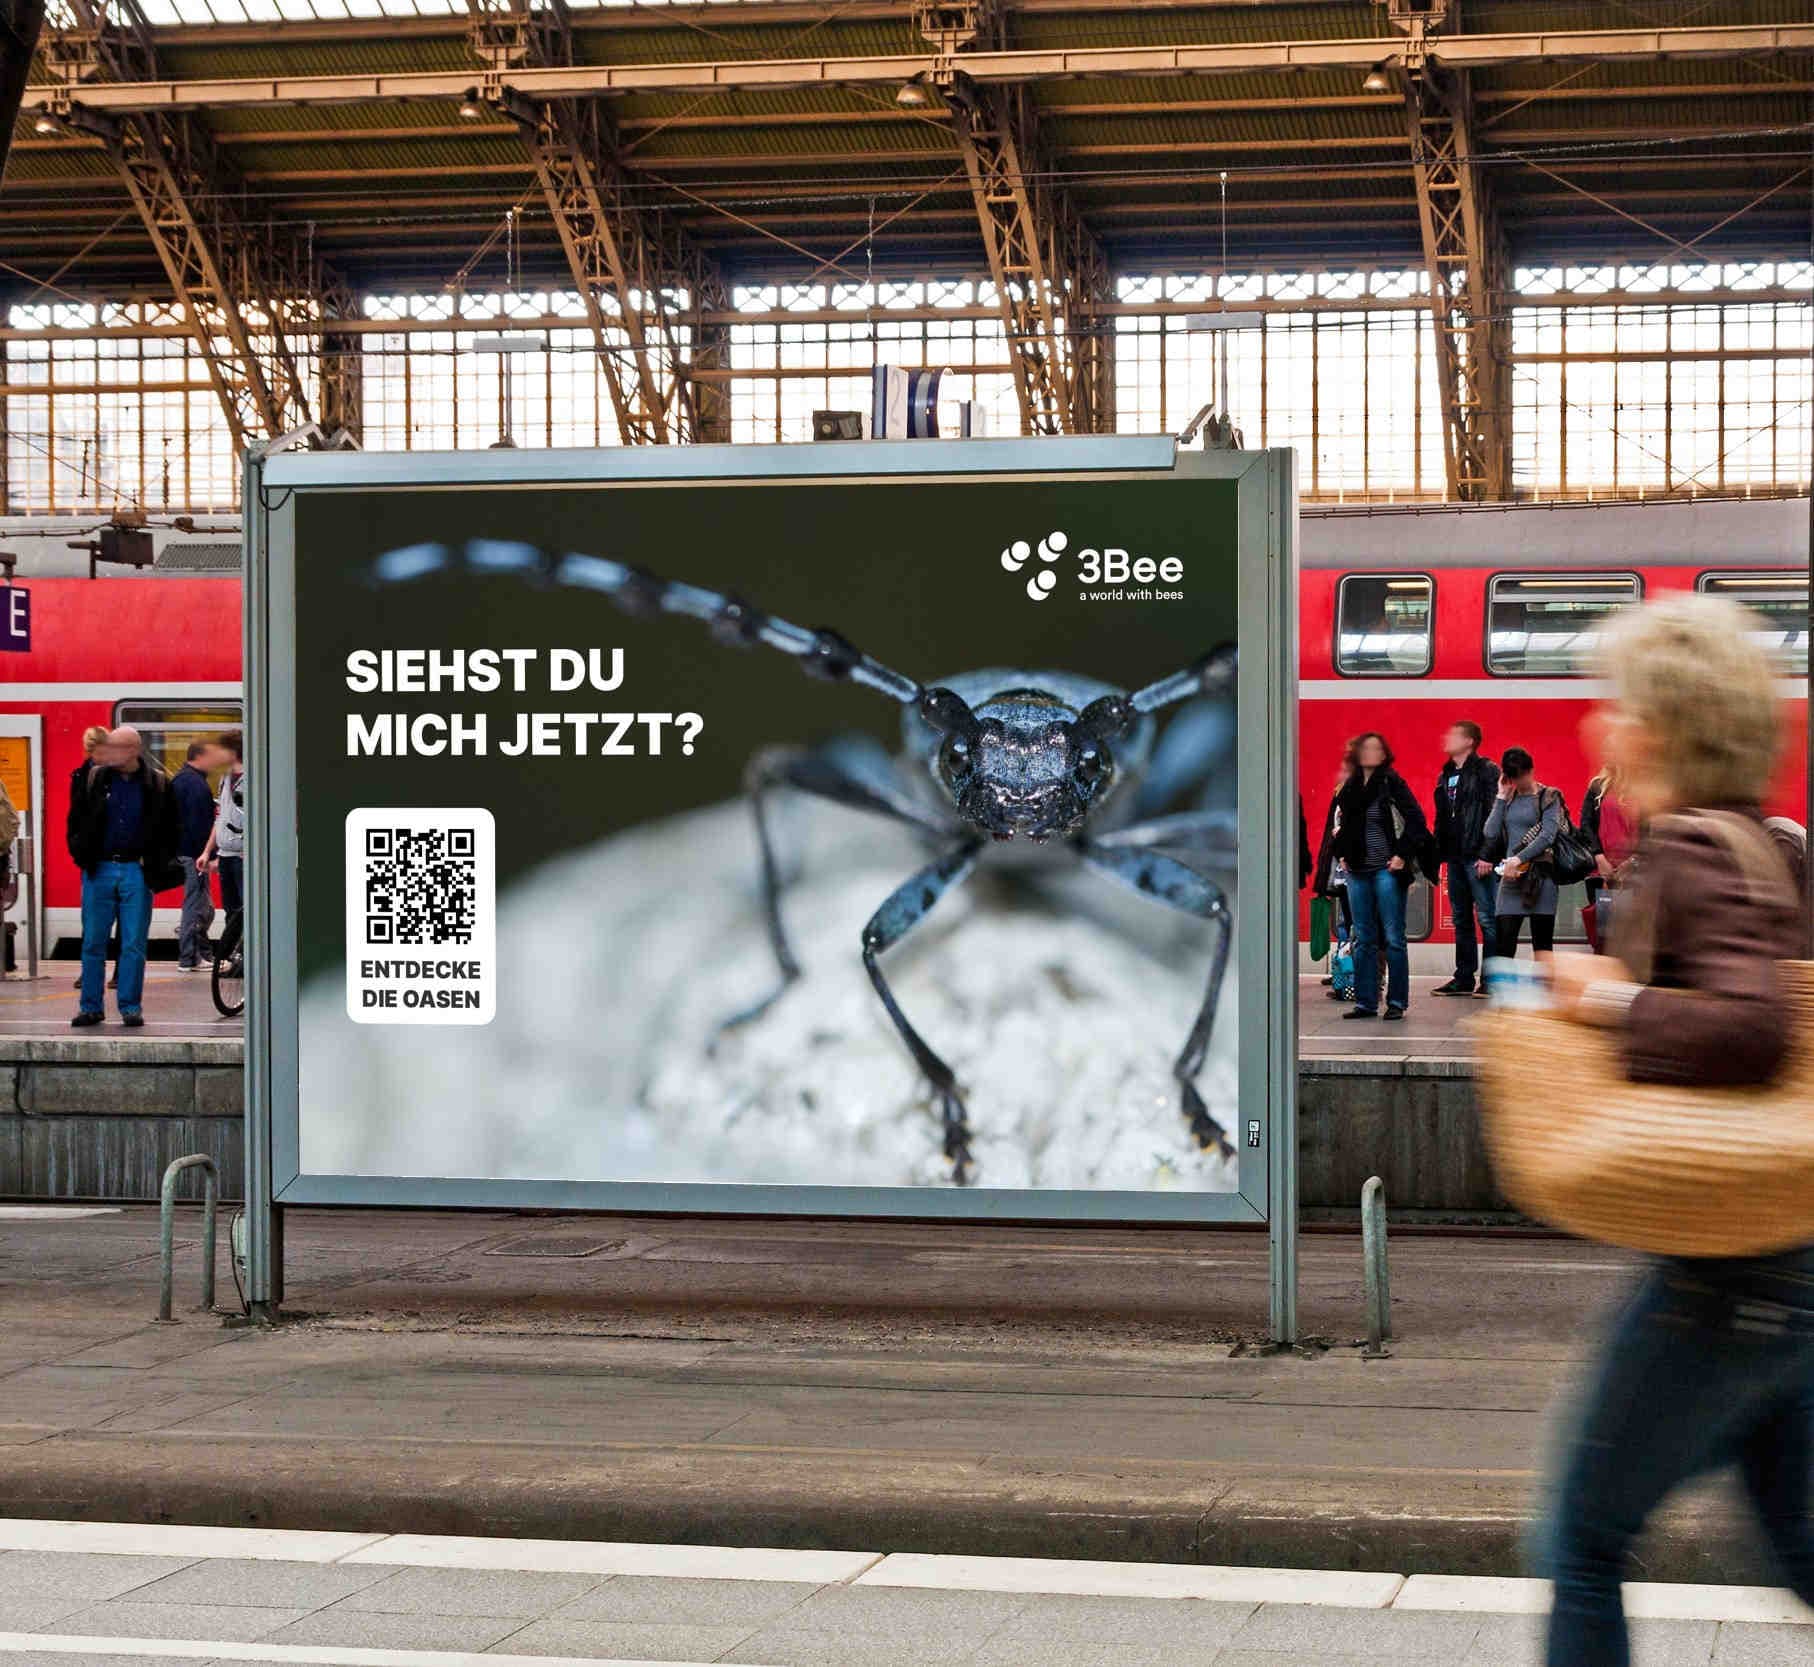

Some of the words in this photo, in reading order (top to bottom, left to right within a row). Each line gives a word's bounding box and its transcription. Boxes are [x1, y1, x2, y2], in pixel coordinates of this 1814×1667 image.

[1078, 549, 1184, 584] 3Bee
[1079, 592, 1087, 601] a
[1089, 589, 1123, 601] world
[1126, 588, 1152, 601] with
[1155, 588, 1184, 601] bees
[10, 589, 27, 637] E
[346, 649, 536, 693] SIEHST
[551, 648, 624, 692] DU
[347, 713, 487, 757] MICH
[499, 712, 704, 757] JETZT?
[361, 960, 481, 980] ENTDECKE
[362, 989, 398, 1009] DIE
[402, 989, 480, 1009] OASEN
